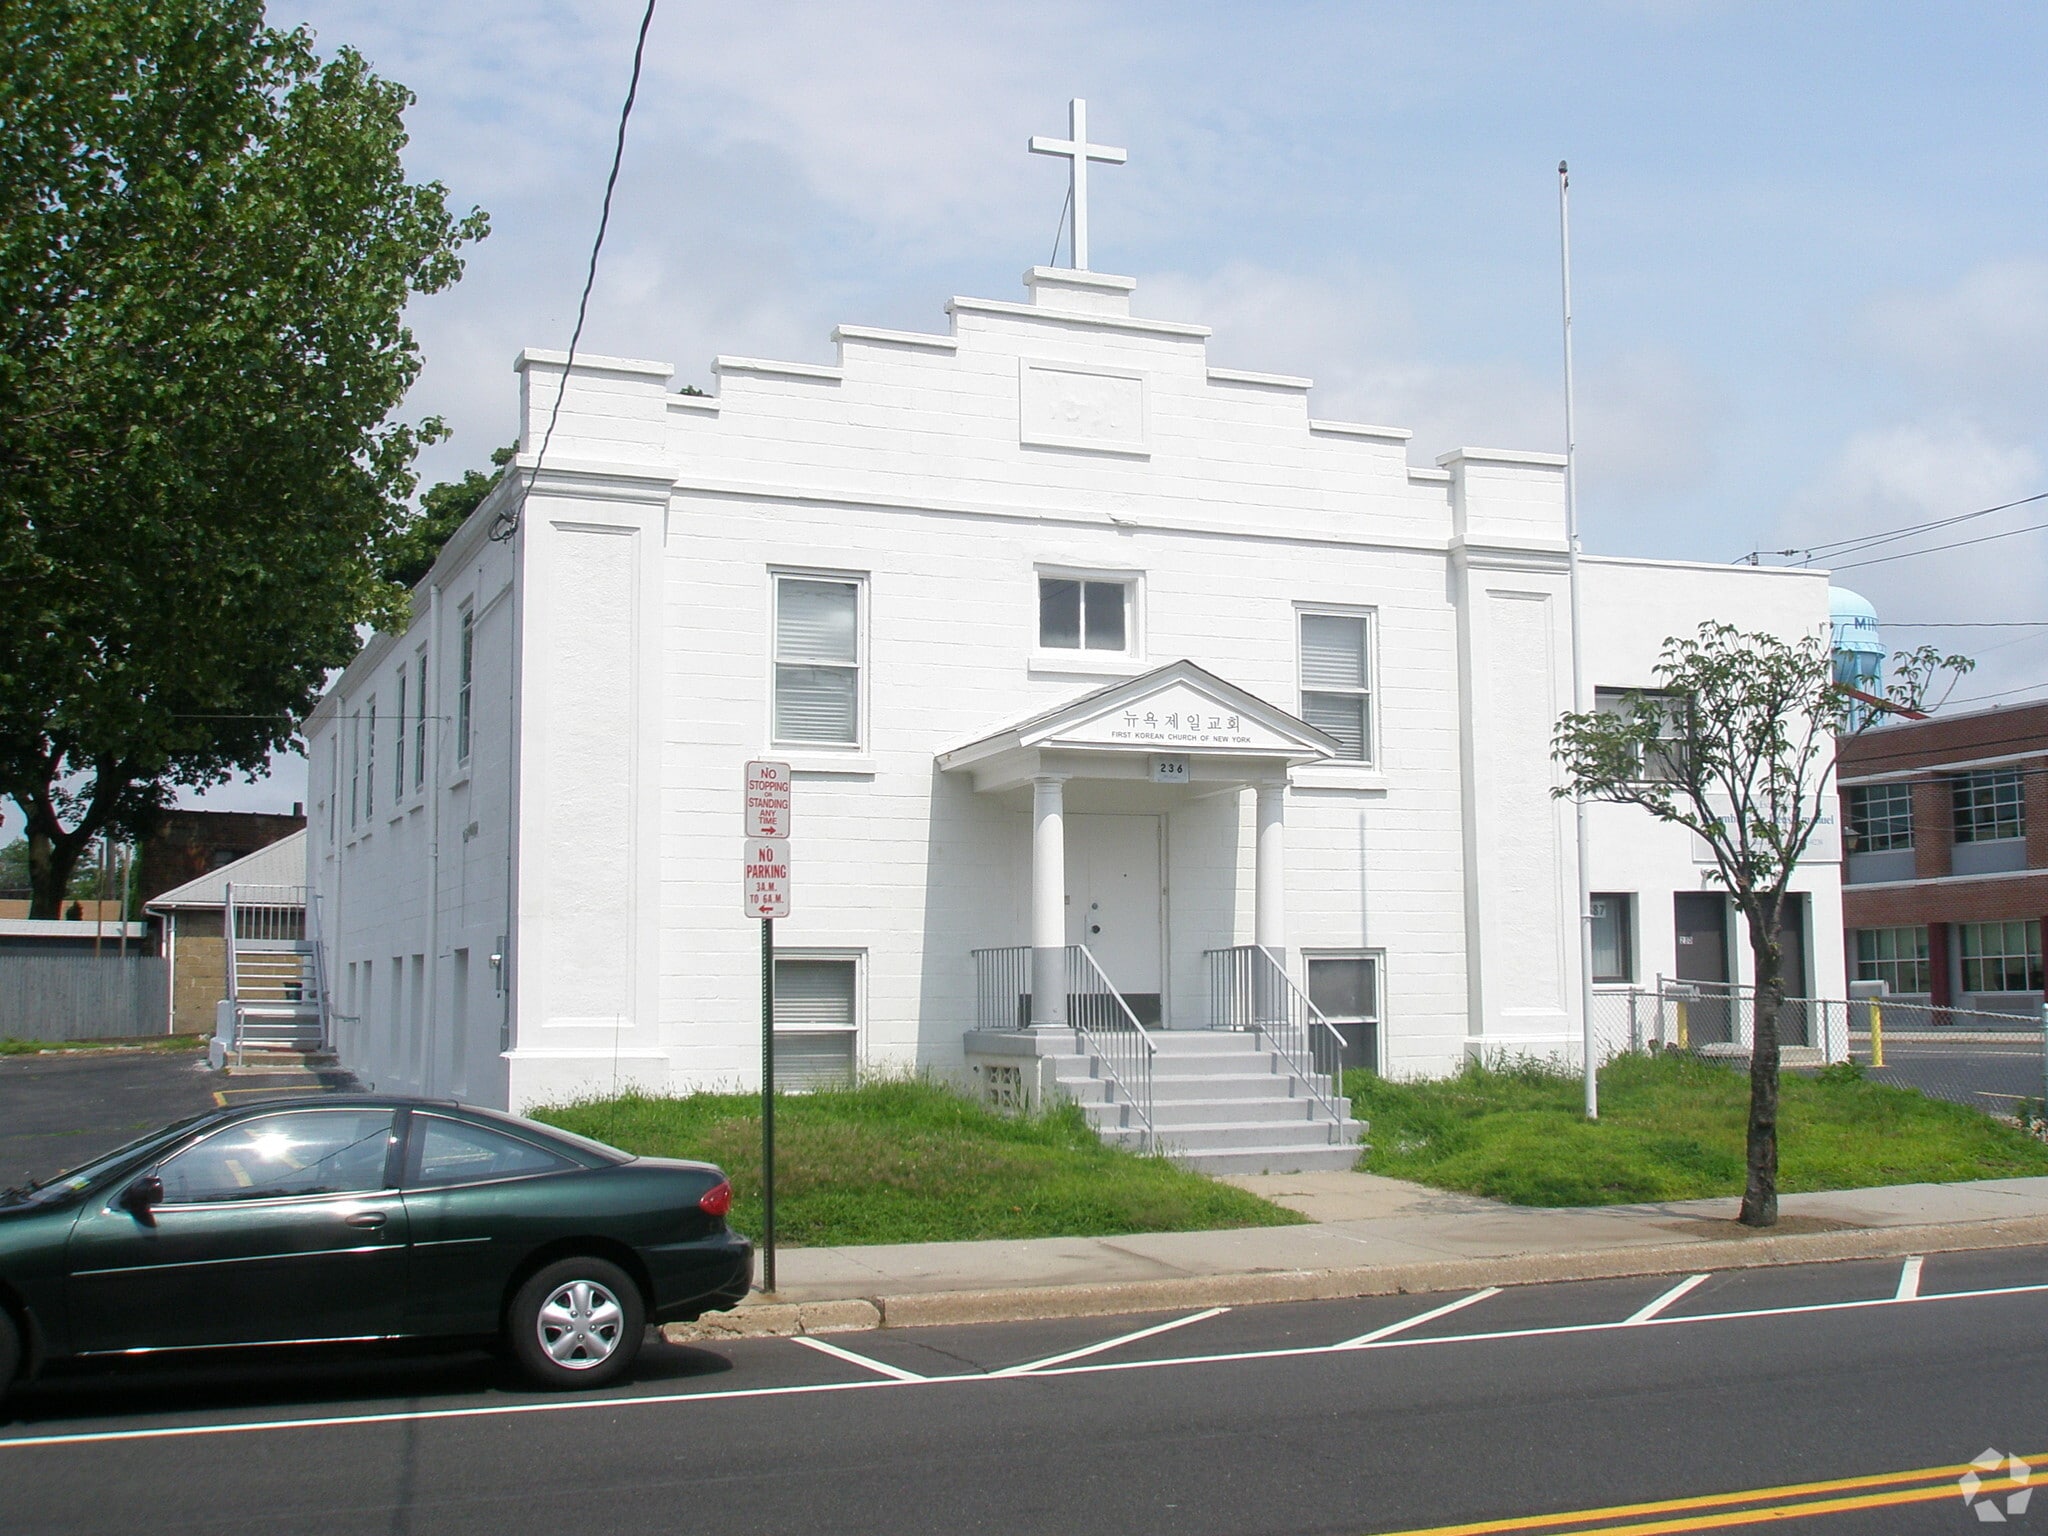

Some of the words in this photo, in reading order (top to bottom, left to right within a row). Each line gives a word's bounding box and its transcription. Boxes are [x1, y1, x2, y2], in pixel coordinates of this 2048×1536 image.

[1123, 711, 1240, 733] 뉴욕제일교회
[1160, 763, 1183, 774] 236
[760, 769, 777, 780] NO
[748, 780, 788, 792] STOPPING
[748, 797, 788, 810] STANDING
[759, 809, 776, 817] ANY
[758, 816, 777, 825] TIME
[758, 848, 773, 863] NO
[746, 864, 787, 879] PARKING
[750, 894, 760, 904] TO
